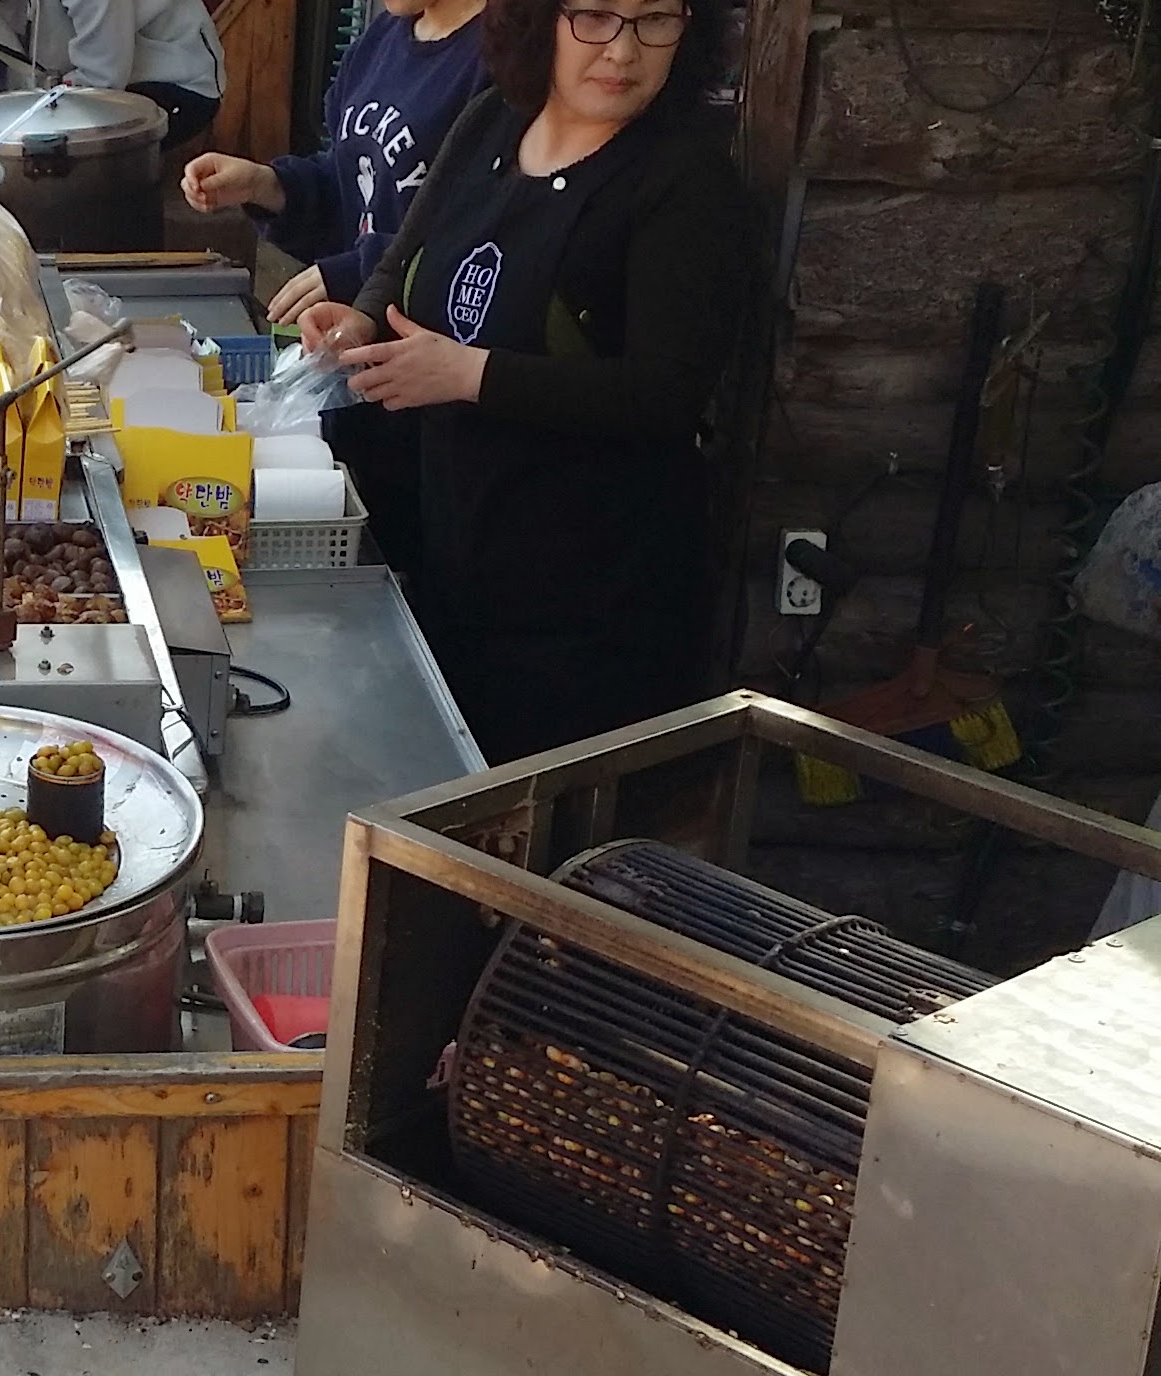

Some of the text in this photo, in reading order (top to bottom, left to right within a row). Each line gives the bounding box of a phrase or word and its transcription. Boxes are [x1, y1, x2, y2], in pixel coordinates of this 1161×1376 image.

[340, 101, 428, 194] ICKEY
[462, 263, 493, 287] HO
[456, 284, 486, 307] ME
[454, 305, 479, 325] CEO
[175, 480, 233, 510] 약단밤
